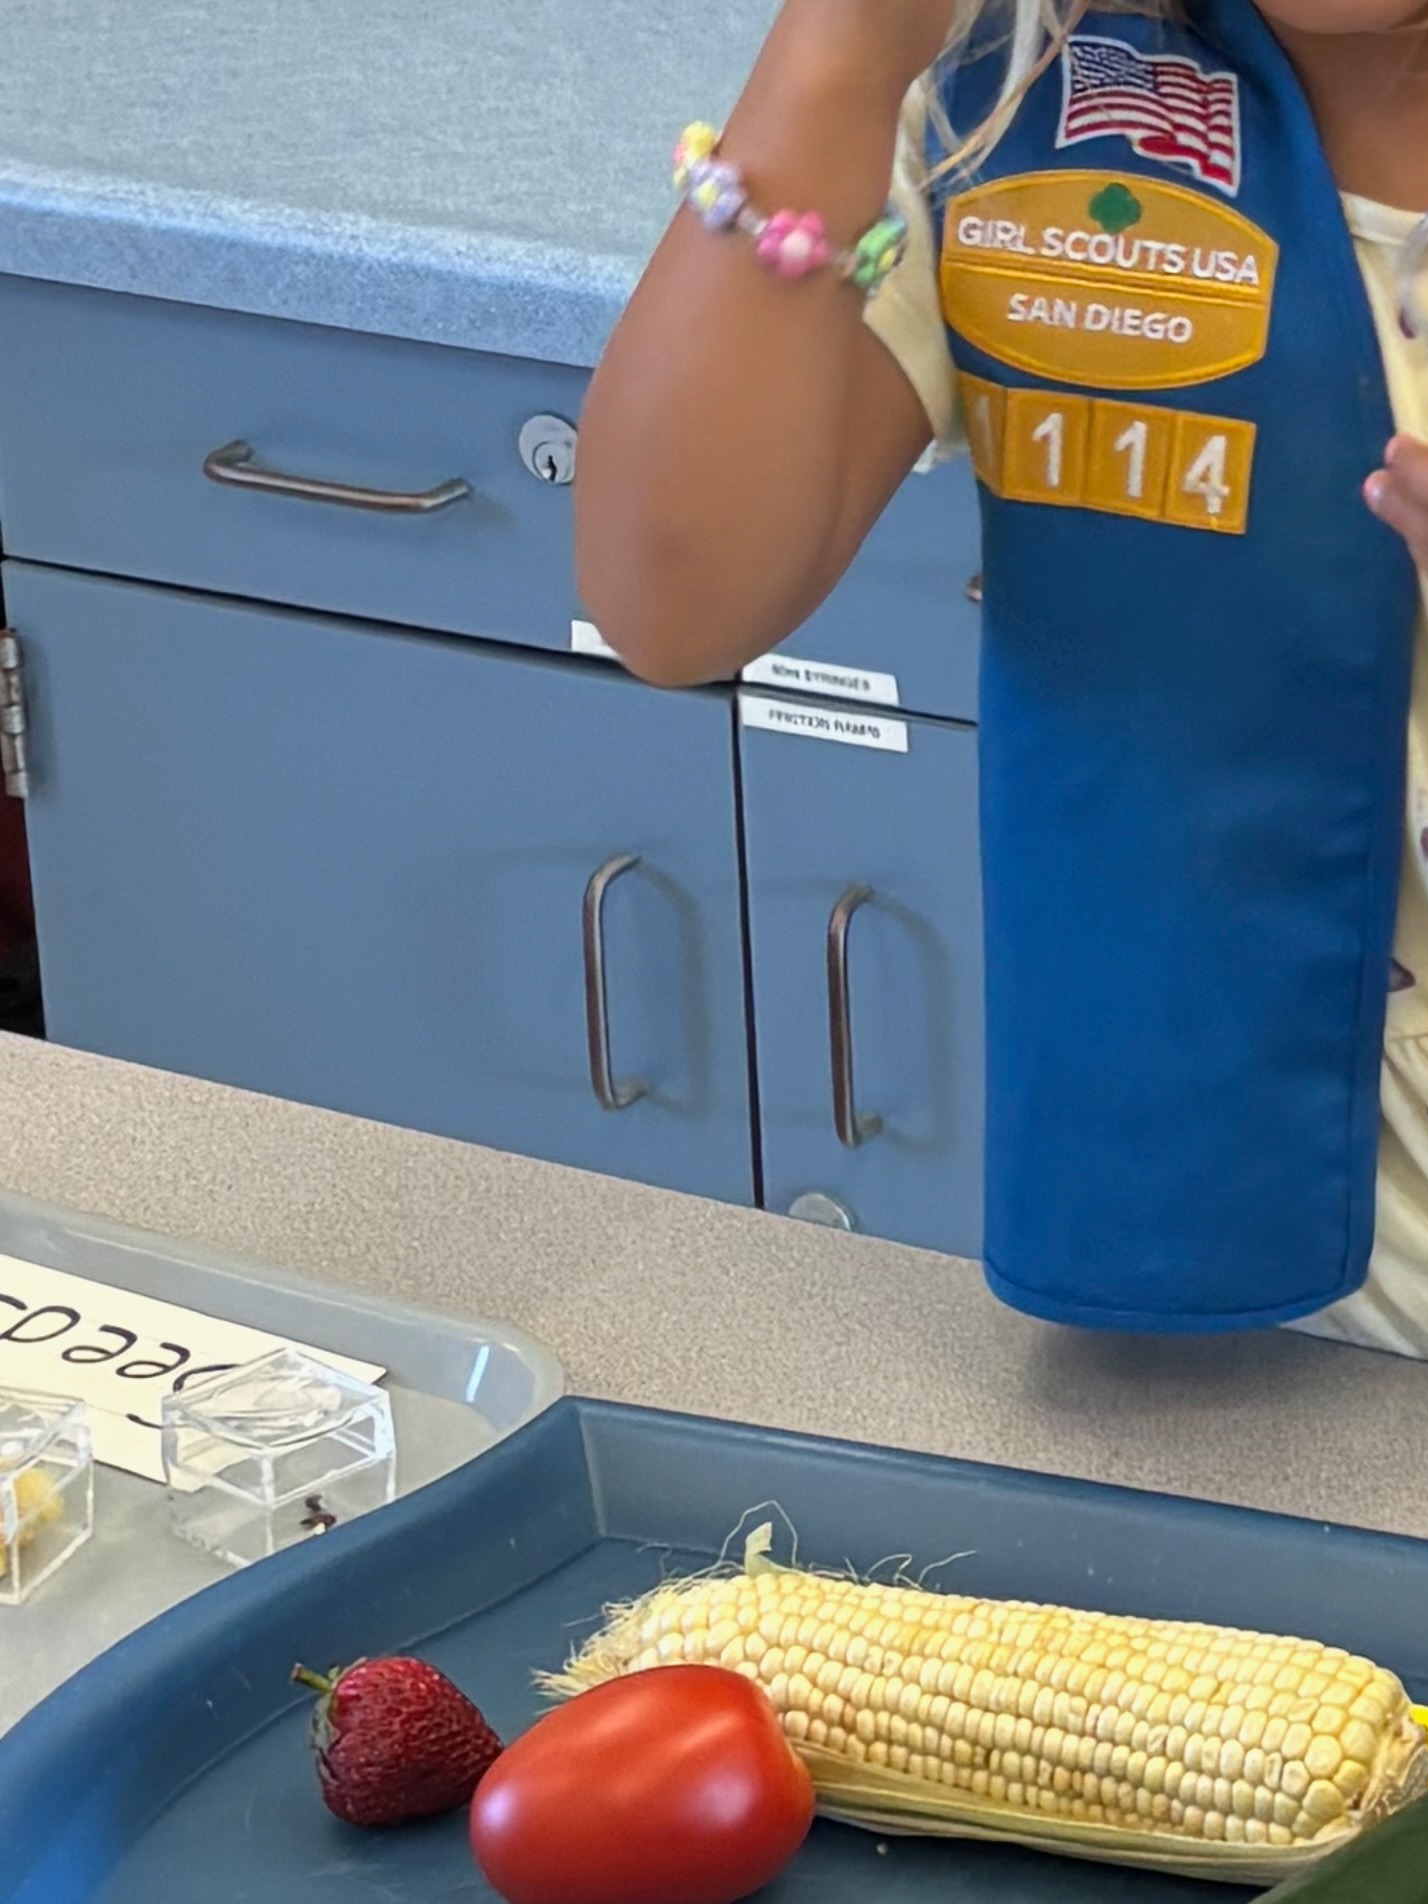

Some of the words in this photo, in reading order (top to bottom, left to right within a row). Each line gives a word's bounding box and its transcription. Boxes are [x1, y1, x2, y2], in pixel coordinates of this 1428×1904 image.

[956, 215, 1035, 257] GIRL
[1040, 225, 1187, 277] SCOUTS
[1190, 245, 1260, 287] USA
[1006, 292, 1078, 330] SAN
[1084, 302, 1193, 345] DIEGO
